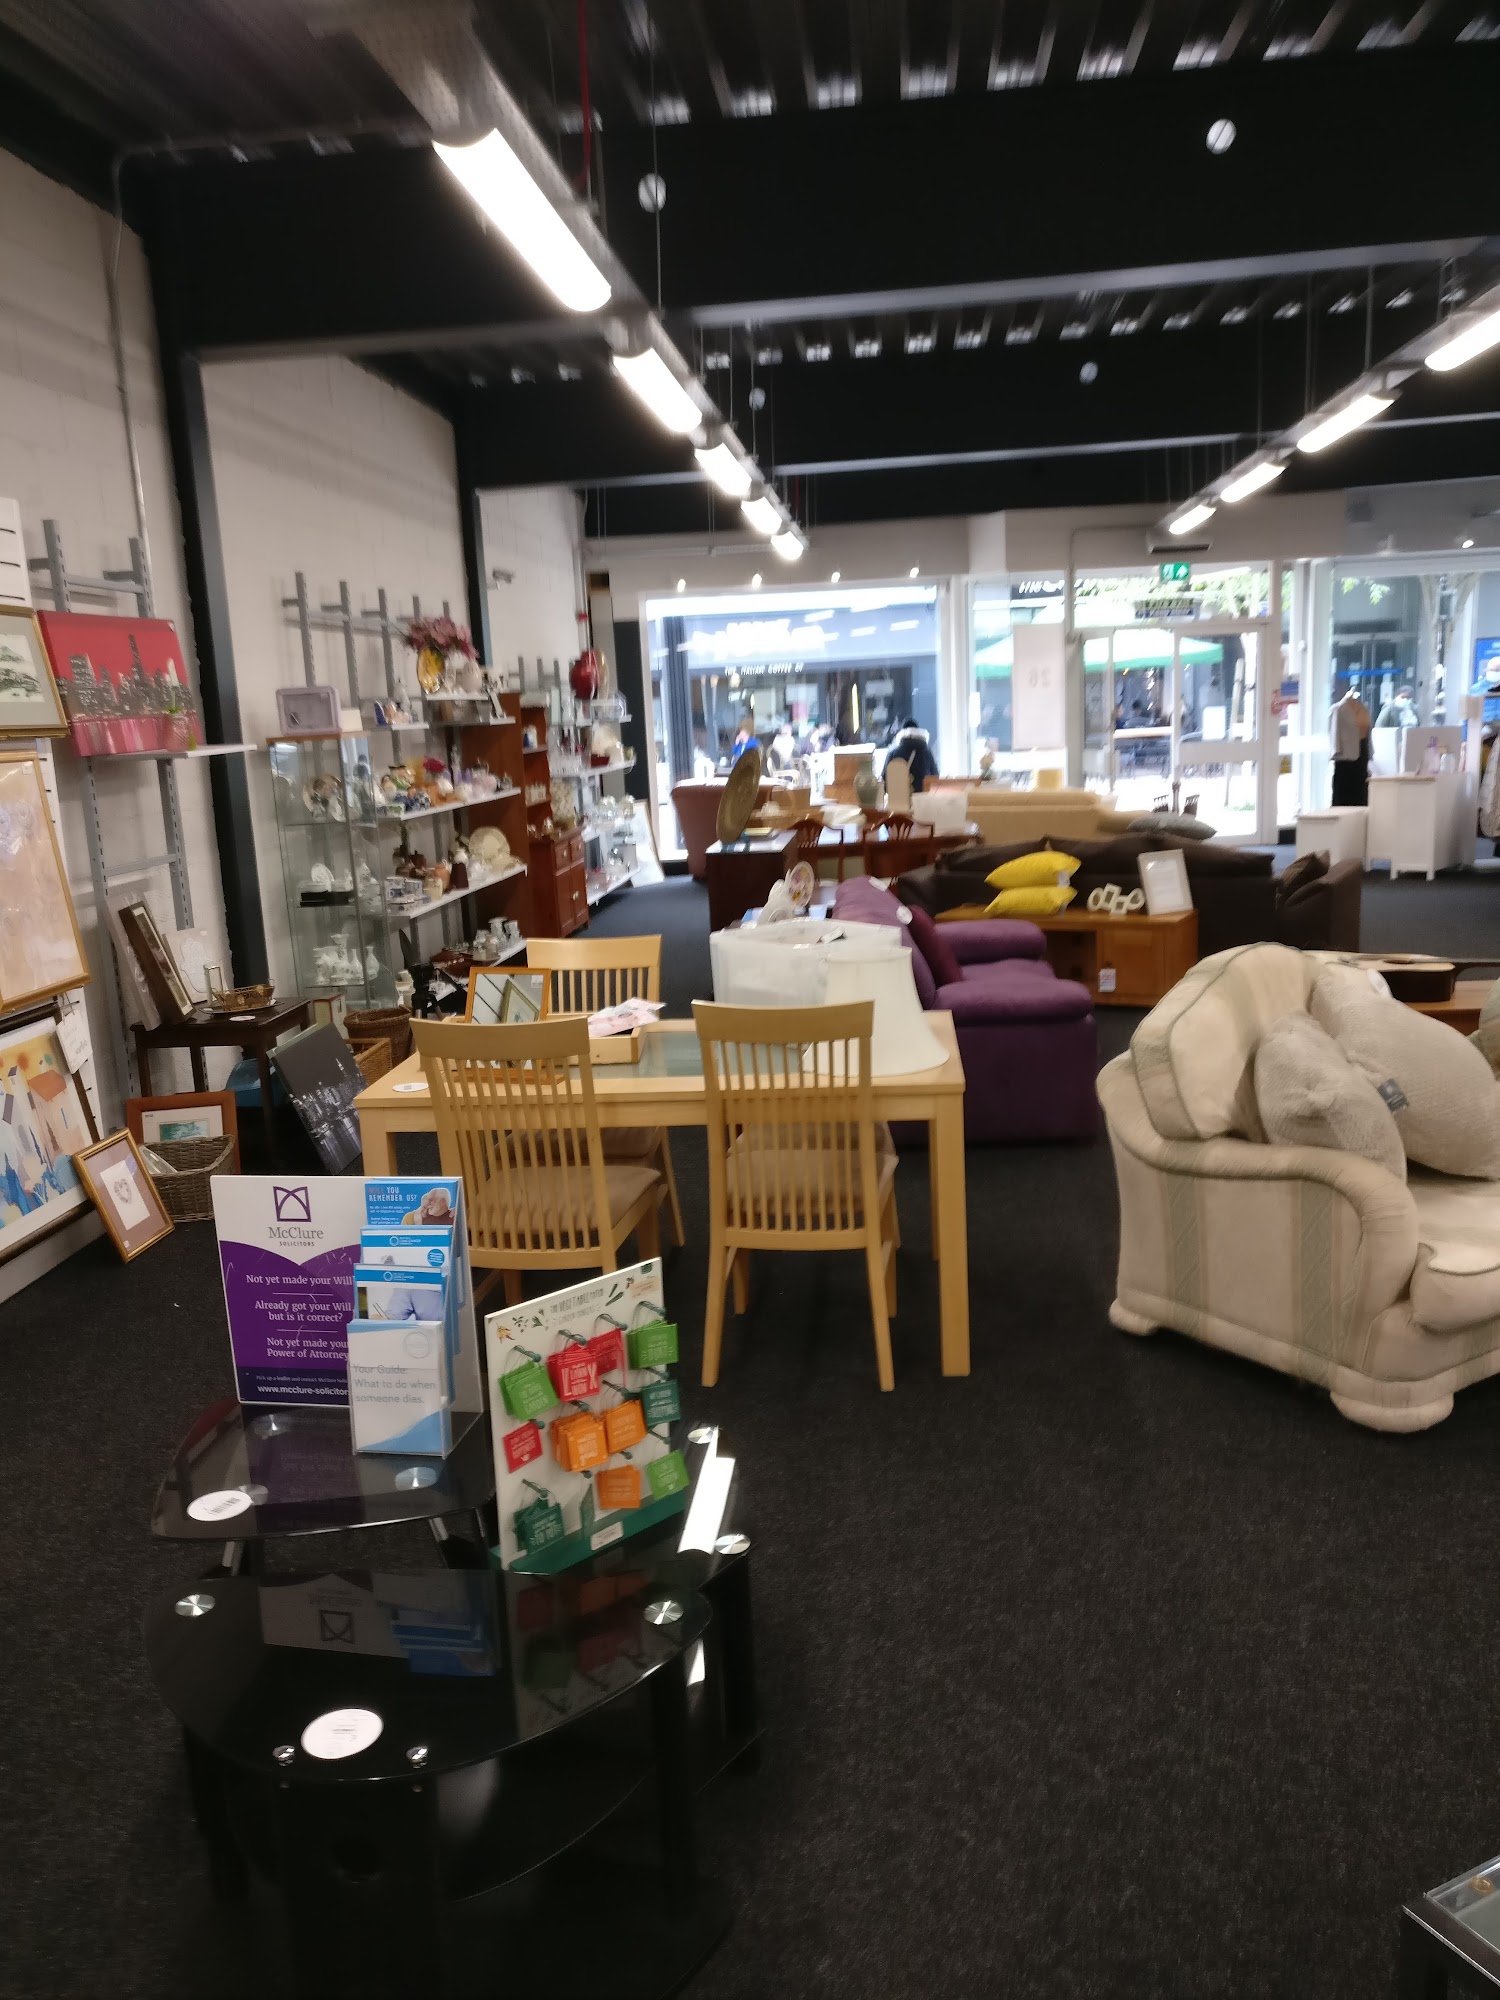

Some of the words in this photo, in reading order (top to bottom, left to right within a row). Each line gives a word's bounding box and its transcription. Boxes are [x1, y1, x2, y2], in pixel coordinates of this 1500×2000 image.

[386, 1186, 399, 1194] YOU
[368, 1194, 403, 1202] REMEMBER
[406, 1194, 417, 1202] US?
[268, 1226, 324, 1239] McClure
[246, 1274, 263, 1283] Not
[265, 1276, 280, 1286] yet
[282, 1275, 307, 1284] made
[309, 1277, 331, 1286] your
[255, 1300, 289, 1311] Already
[292, 1302, 307, 1312] got
[309, 1303, 331, 1313] your
[268, 1311, 284, 1321] but
[286, 1312, 295, 1321] is
[297, 1312, 305, 1321] it
[306, 1313, 343, 1322] correct?
[266, 1337, 284, 1346] Not
[286, 1339, 300, 1348] yet
[302, 1339, 328, 1348] made
[267, 1348, 295, 1358] Power
[297, 1349, 307, 1358] of
[353, 1364, 374, 1373] Your
[354, 1379, 380, 1388] What
[382, 1380, 393, 1389] to
[395, 1380, 407, 1389] do
[410, 1380, 436, 1389] when
